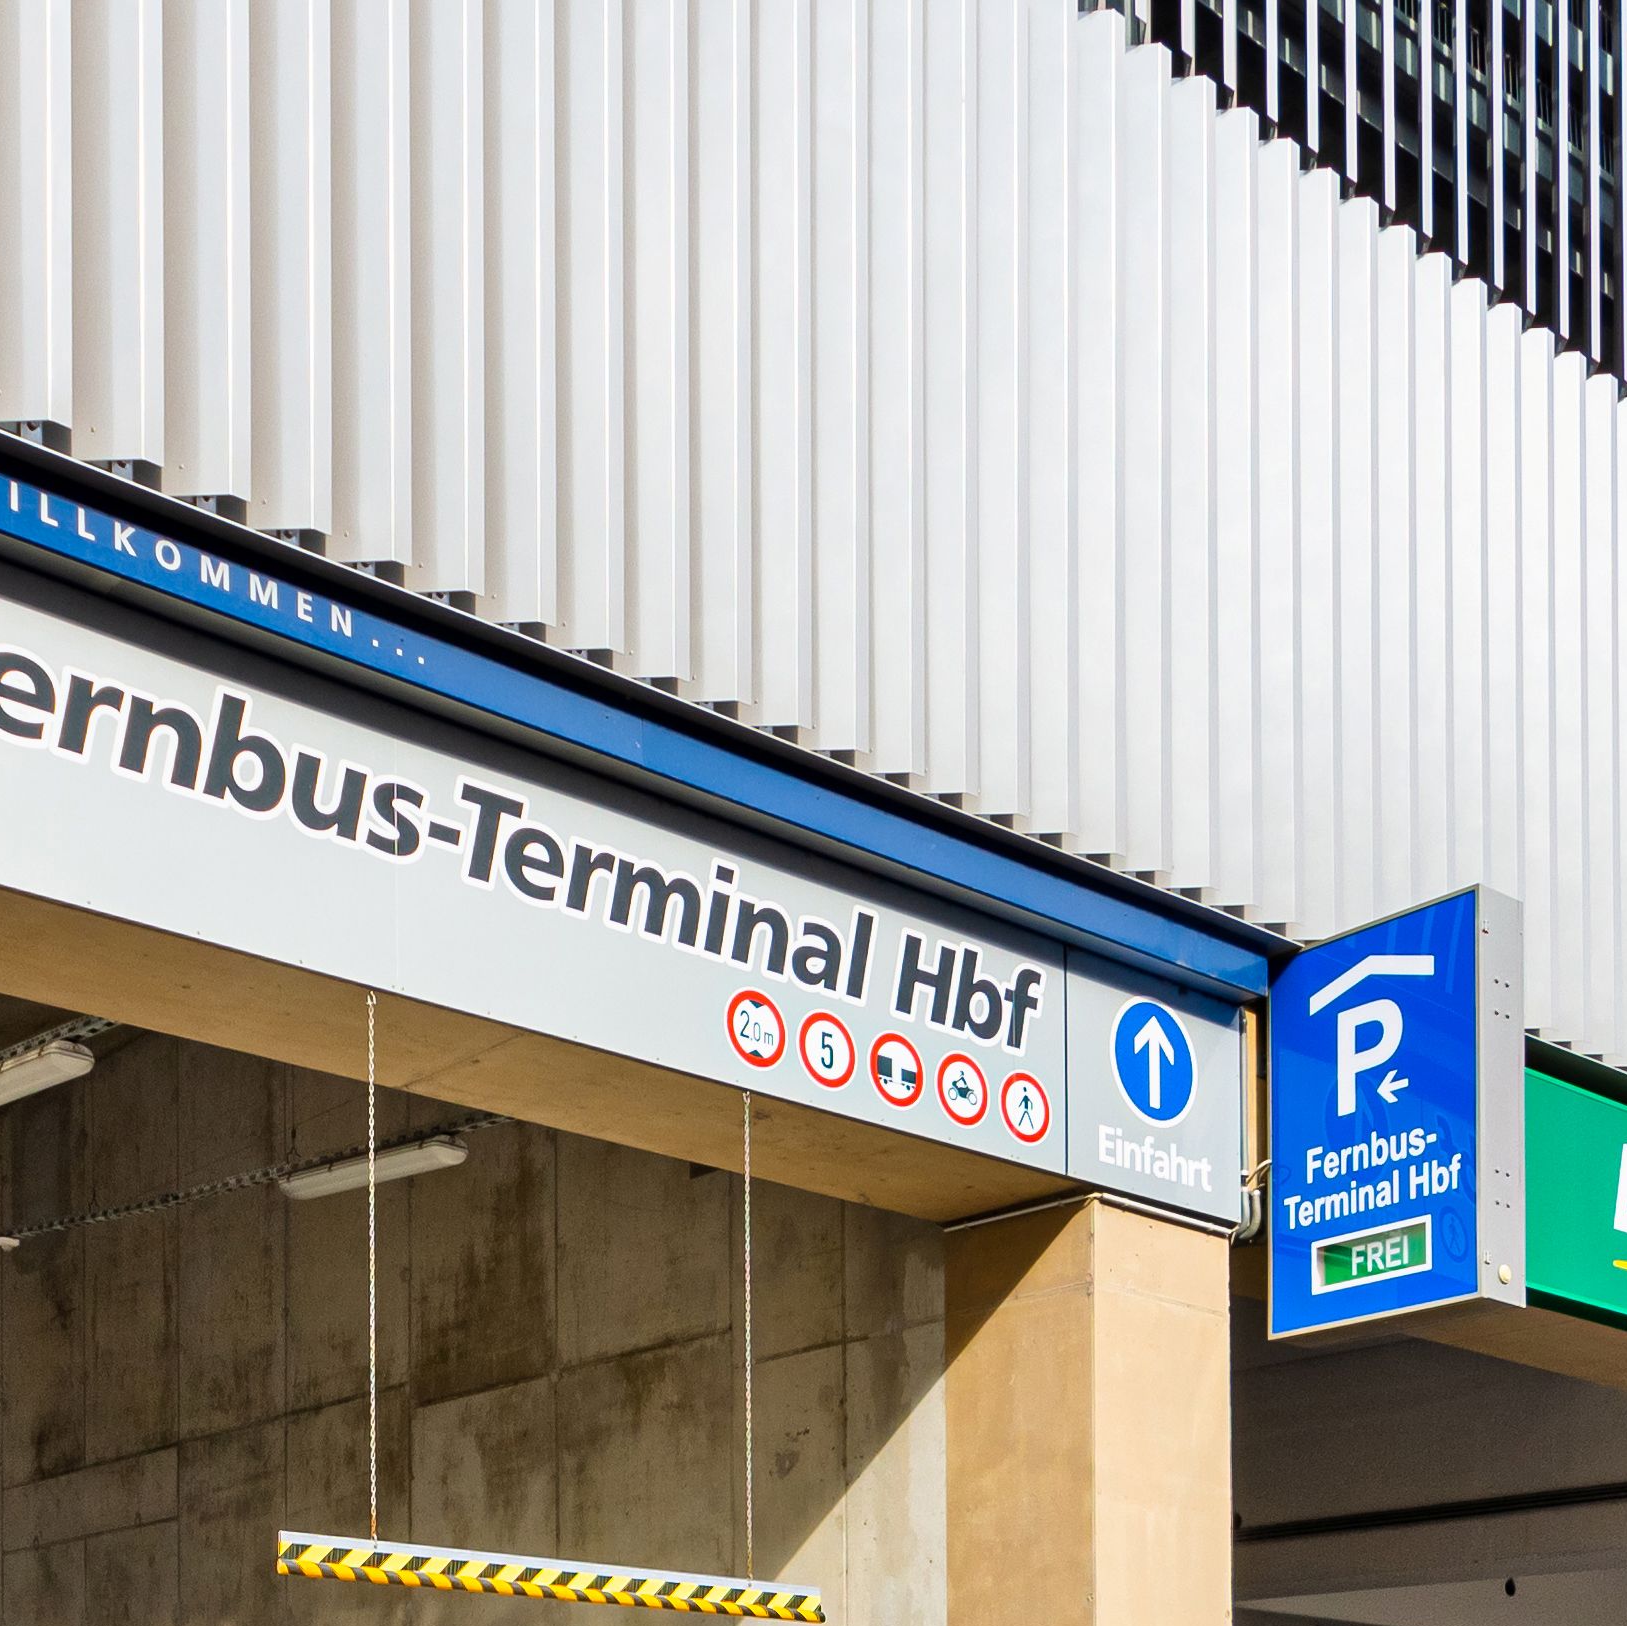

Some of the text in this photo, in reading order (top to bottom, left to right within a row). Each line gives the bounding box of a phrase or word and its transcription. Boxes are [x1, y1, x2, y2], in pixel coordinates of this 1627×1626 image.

[896, 934, 1042, 1048] Hbf
[821, 1031, 834, 1069] 5
[1337, 998, 1403, 1116] P
[1098, 1125, 1212, 1192] Einfahrt
[1306, 1128, 1437, 1184] Fernbus-
[1283, 1152, 1462, 1230] Terminal Hbf
[1351, 1234, 1410, 1276] FREI
